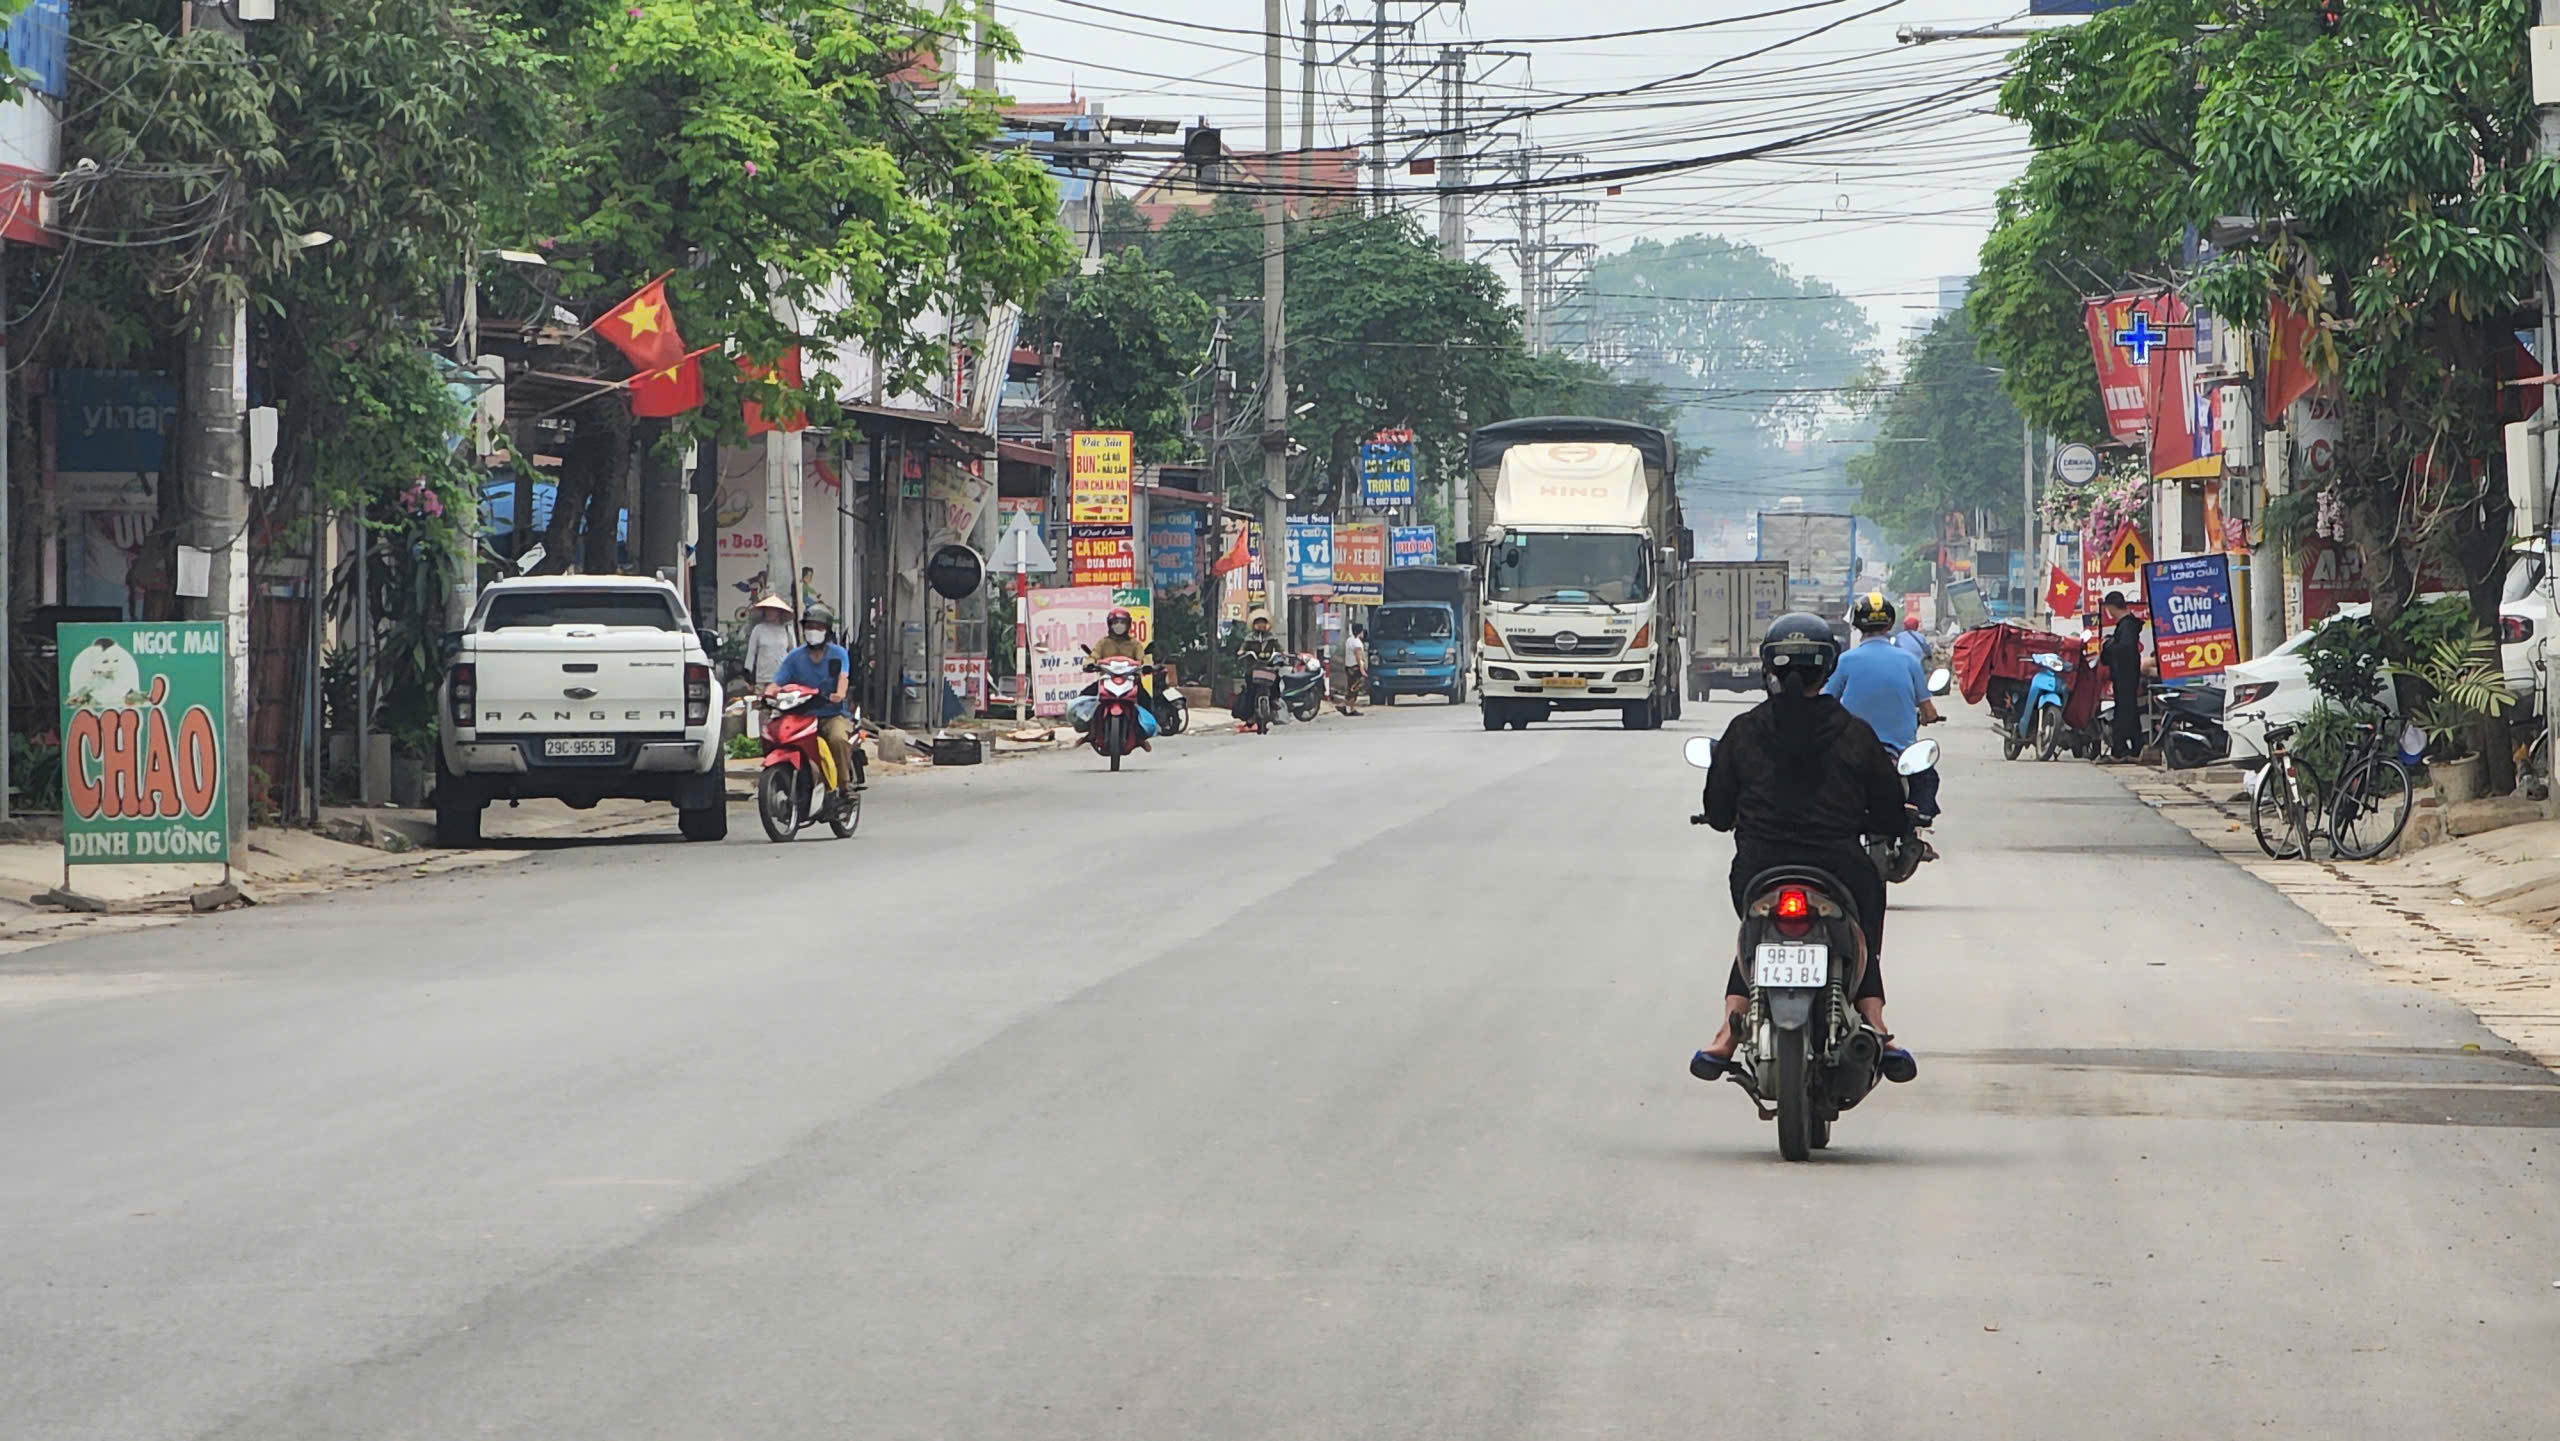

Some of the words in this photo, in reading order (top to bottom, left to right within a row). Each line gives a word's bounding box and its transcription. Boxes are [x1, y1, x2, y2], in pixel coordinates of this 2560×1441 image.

[132, 631, 178, 660] NGỌC
[183, 631, 219, 654] MAI
[485, 711, 676, 721] RANGER
[67, 675, 219, 820] CHÁO
[69, 832, 130, 856] DINH
[136, 824, 222, 856] DƯỠNG
